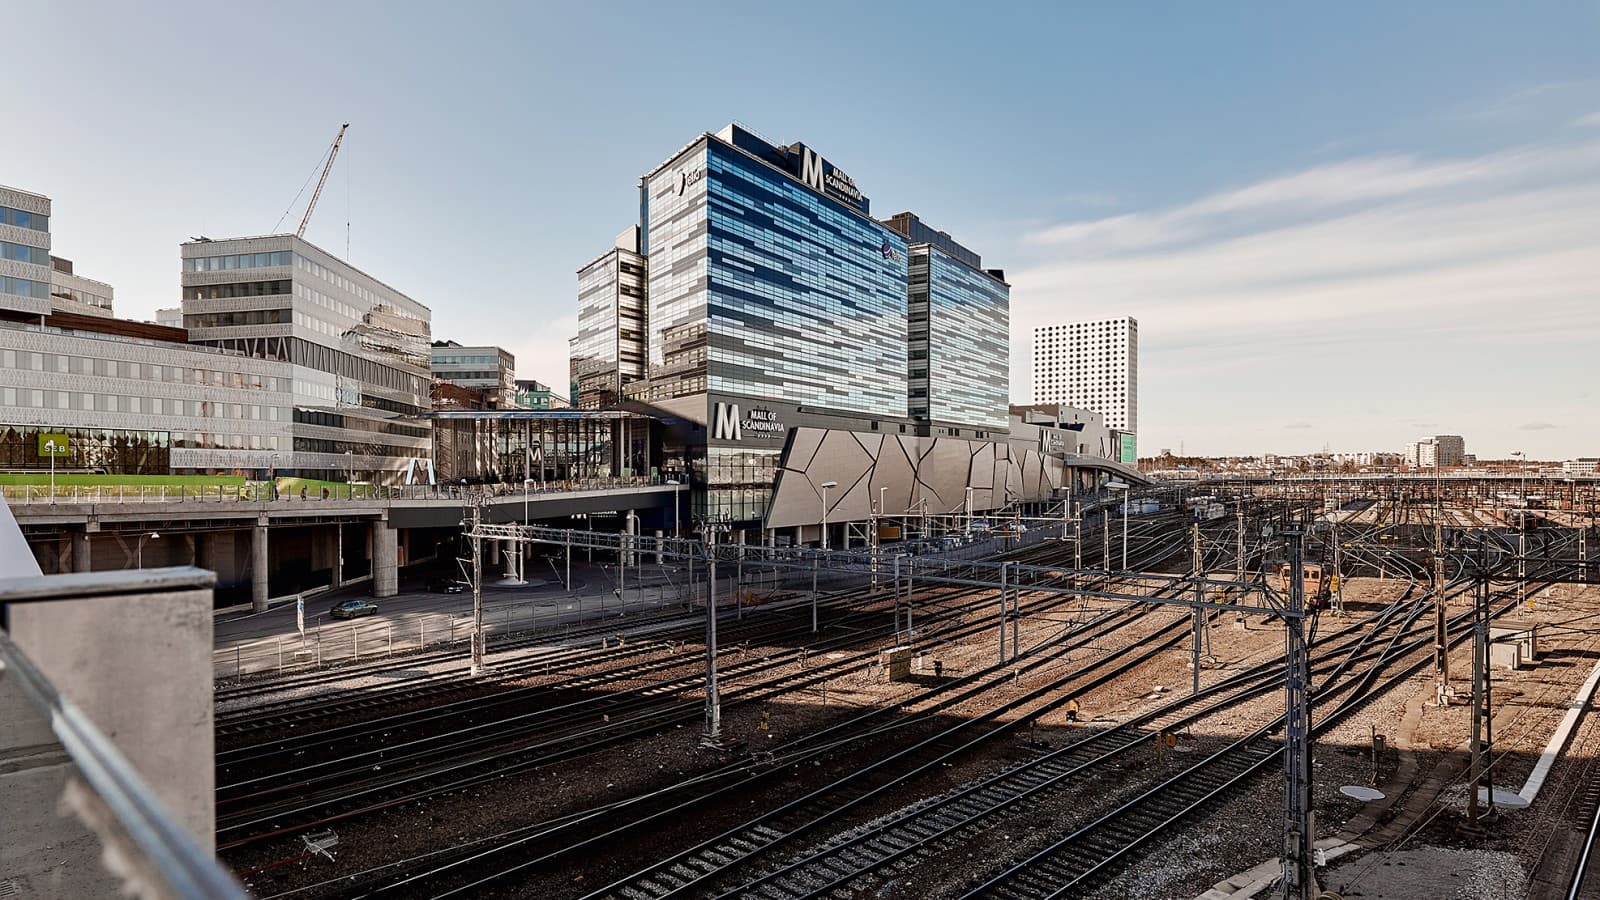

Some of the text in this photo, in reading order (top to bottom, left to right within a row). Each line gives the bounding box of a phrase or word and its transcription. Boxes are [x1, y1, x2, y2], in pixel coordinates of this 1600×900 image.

[802, 147, 824, 192] M
[833, 168, 848, 184] MALL
[715, 402, 741, 440] M
[751, 410, 777, 421] MALL OF
[742, 420, 785, 432] SCANDINAVIA
